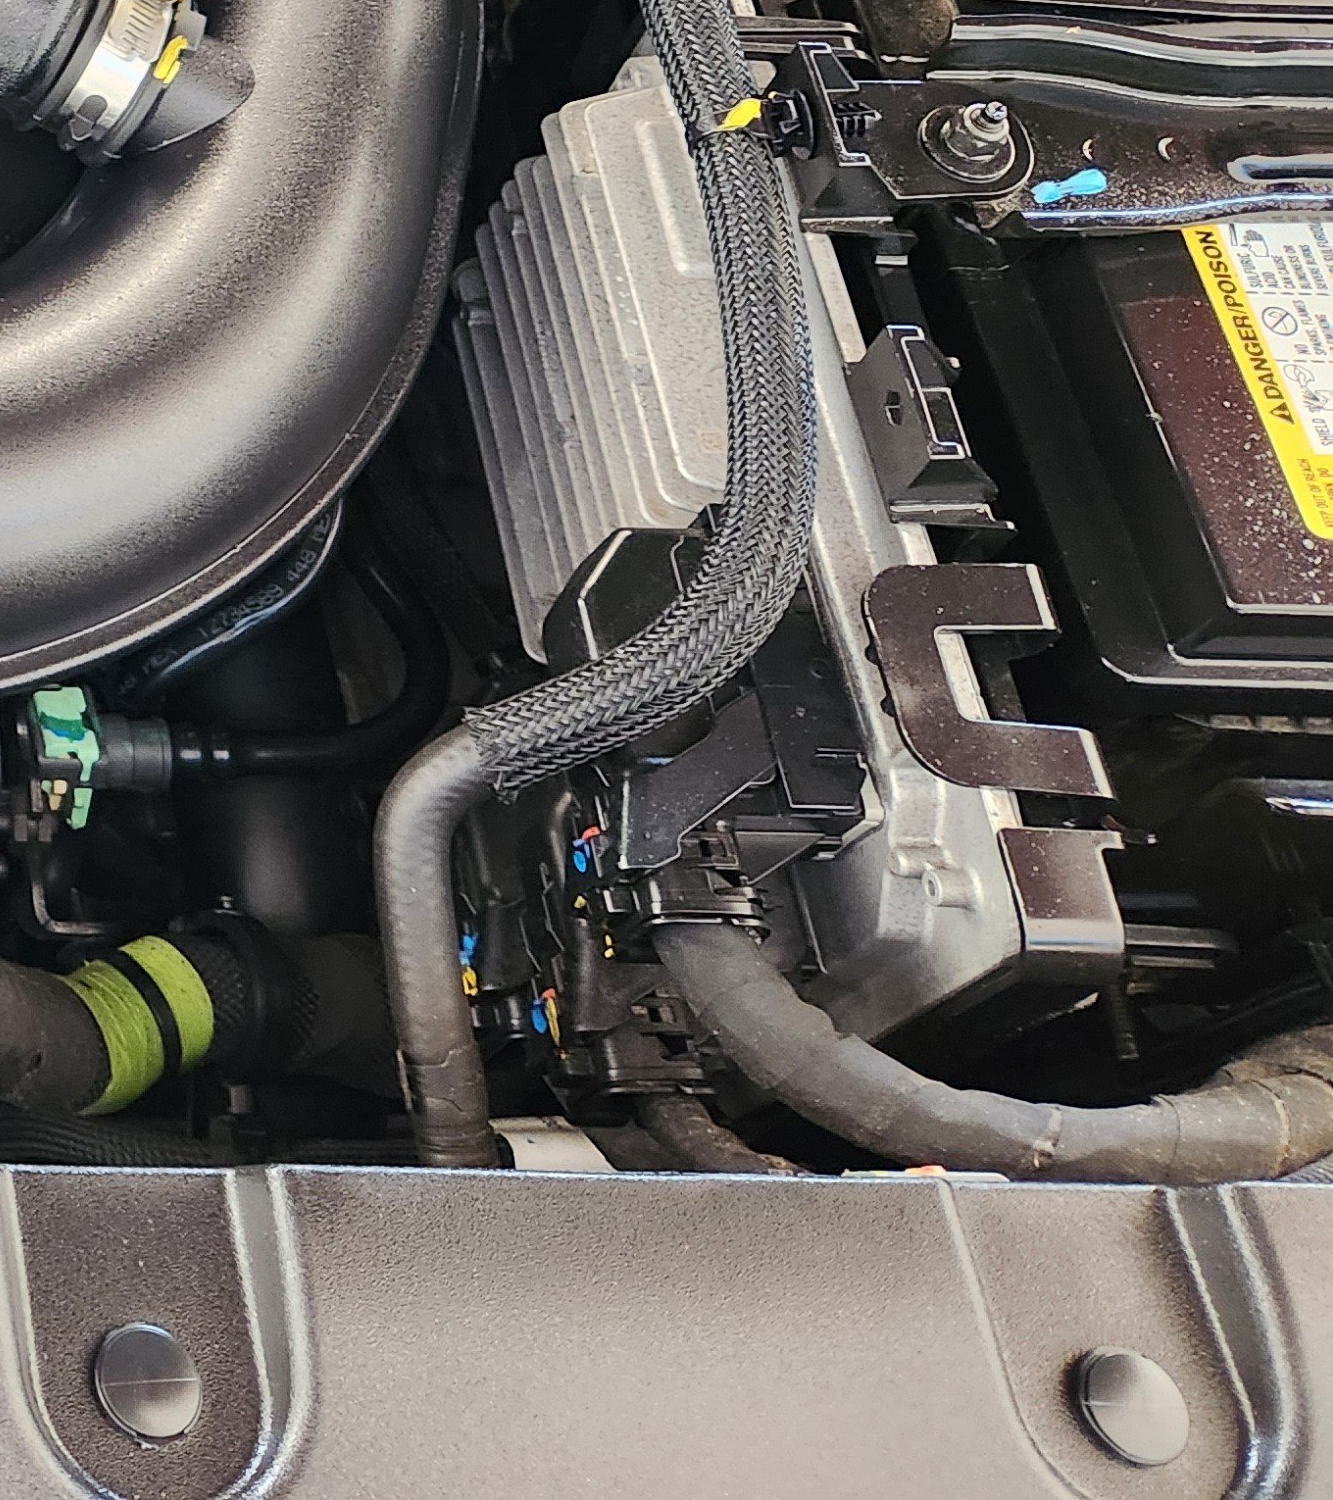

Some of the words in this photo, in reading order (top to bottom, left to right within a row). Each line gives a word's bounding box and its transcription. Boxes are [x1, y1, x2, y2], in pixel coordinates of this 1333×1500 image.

[1234, 253, 1264, 287] SULFURIC
[1260, 271, 1280, 288] ACID
[1195, 230, 1285, 400] DANGER/POISON
[1290, 299, 1314, 325] FLAMES
[1310, 417, 1333, 445] SHIELD
